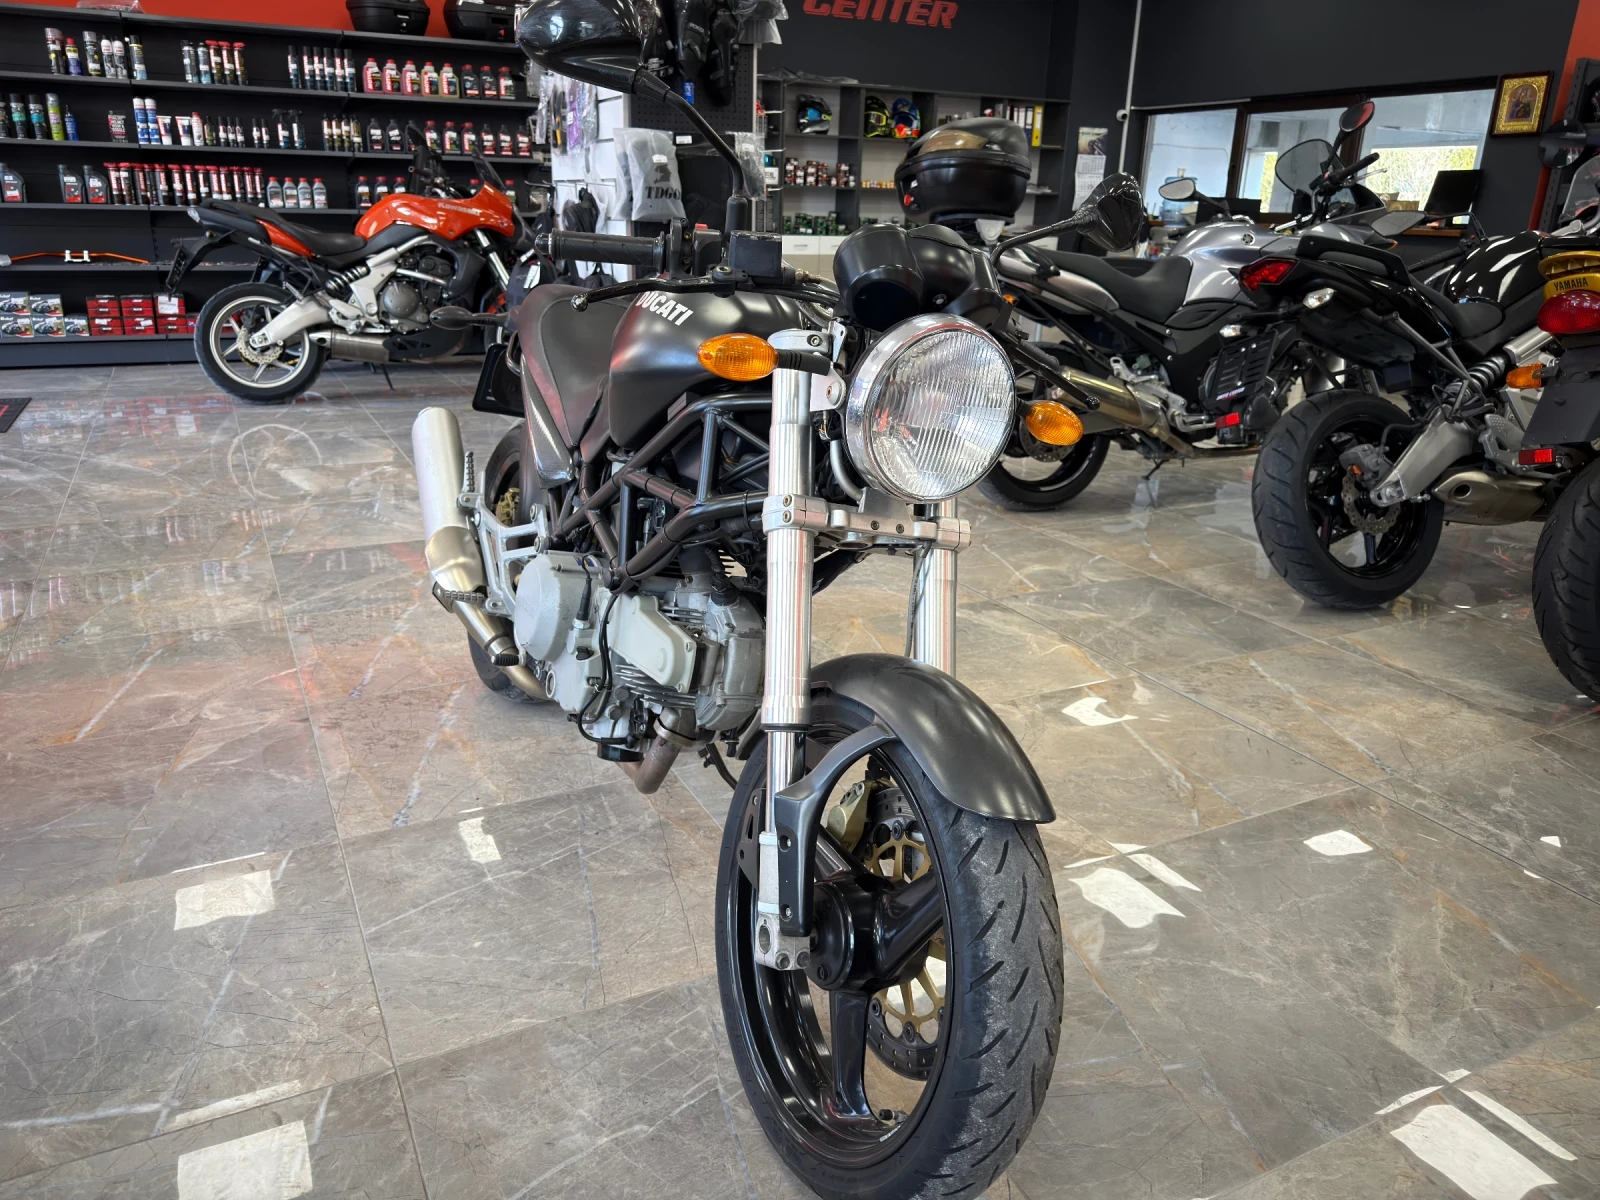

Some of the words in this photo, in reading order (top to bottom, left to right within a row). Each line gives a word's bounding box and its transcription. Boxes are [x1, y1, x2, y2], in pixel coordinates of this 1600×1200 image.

[802, 0, 959, 29] CENTER
[1553, 277, 1589, 291] YAMAHA
[635, 291, 694, 326] DUCATI
